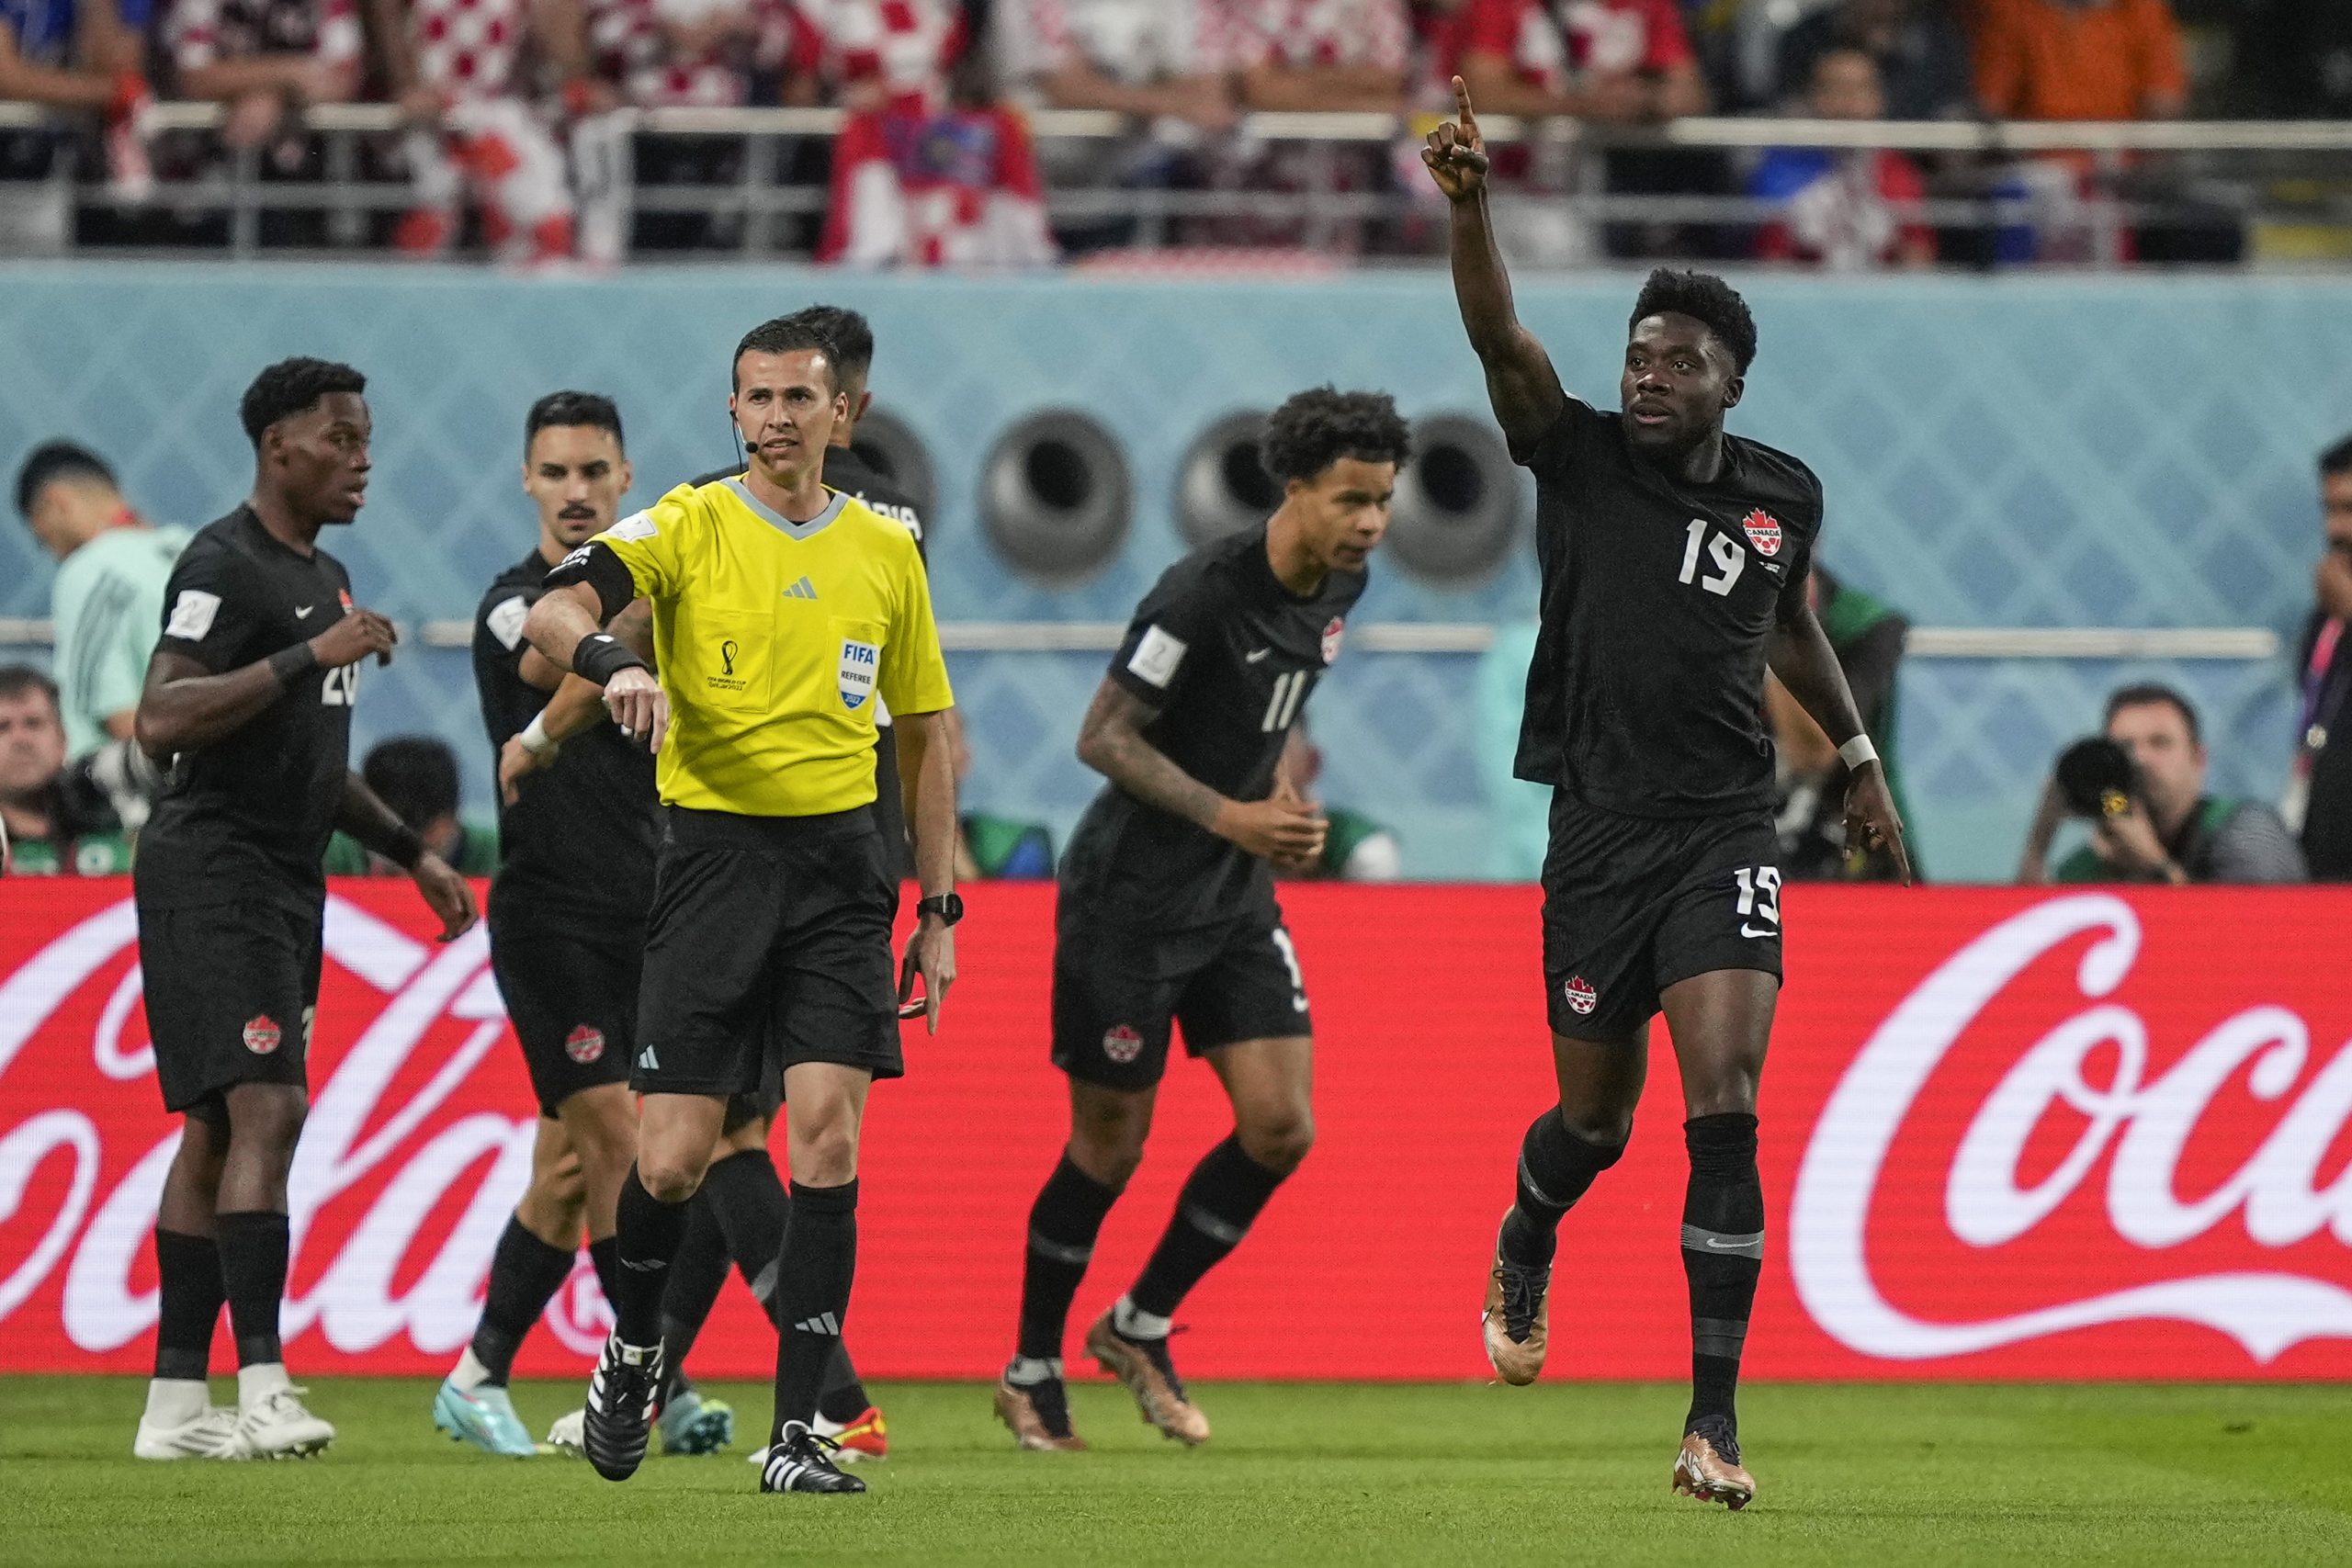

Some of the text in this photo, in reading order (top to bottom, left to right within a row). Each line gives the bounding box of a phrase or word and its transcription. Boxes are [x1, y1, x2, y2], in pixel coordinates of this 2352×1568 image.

[1746, 527, 1781, 537] CANADA
[1679, 518, 1745, 596] 19
[843, 644, 874, 665] FIFA
[841, 670, 872, 685] REFEREE
[1261, 670, 1307, 732] 11
[1734, 865, 1781, 925] 19
[1566, 989, 1595, 1000] CANADA
